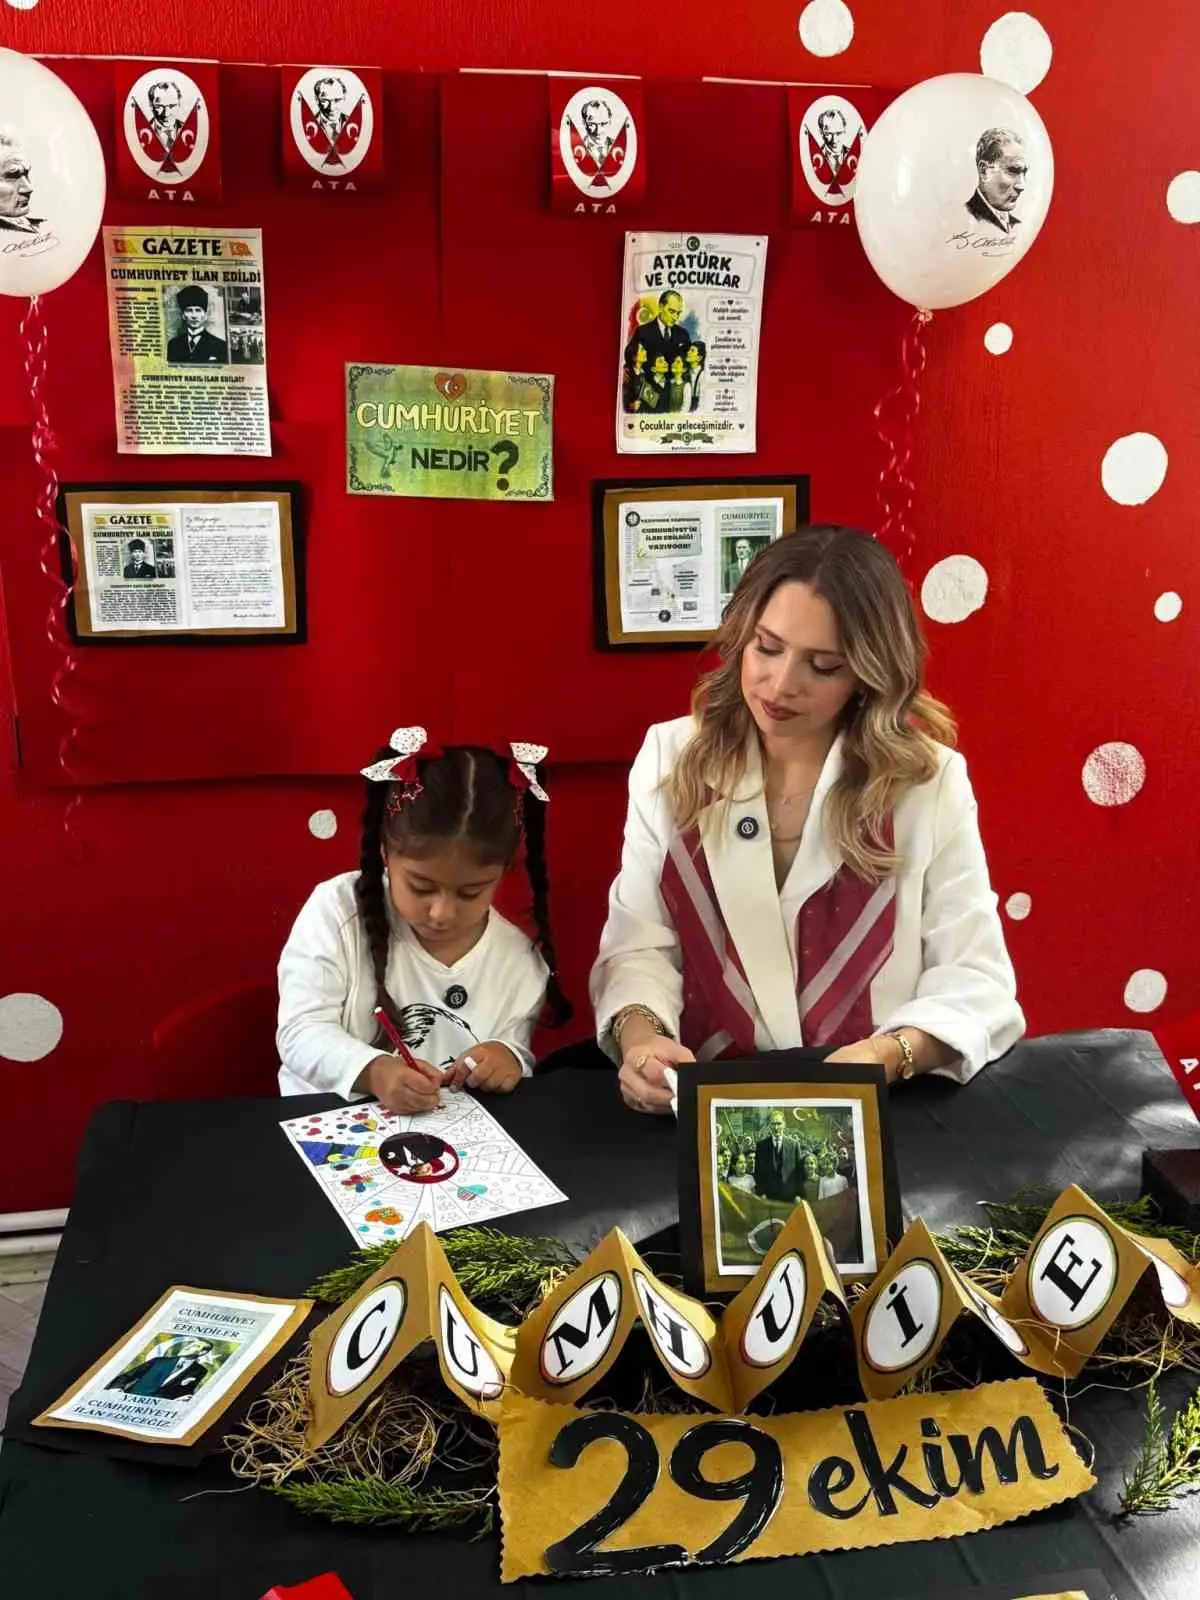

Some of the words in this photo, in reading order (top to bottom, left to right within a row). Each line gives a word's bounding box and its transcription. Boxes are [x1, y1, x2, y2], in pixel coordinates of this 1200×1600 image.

[312, 180, 357, 191] ATA
[148, 189, 195, 201] ATA
[574, 202, 616, 214] ATA
[810, 210, 850, 225] ATA
[142, 238, 222, 256] GAZETE
[653, 252, 732, 271] ATATÜRK
[111, 267, 188, 281] CUMHURİYET
[192, 268, 218, 282] İLAN
[223, 268, 261, 282] EDİLDİ
[645, 273, 662, 287] VE
[668, 271, 740, 288] ÇOCUKLAR
[356, 400, 541, 436] CUMHURİYET
[639, 420, 675, 432] Çocuklar
[677, 420, 734, 432] geleceğimizdir.
[110, 515, 152, 525] GAZETE
[545, 1411, 784, 1575] 29
[807, 1409, 1060, 1520] ekim
